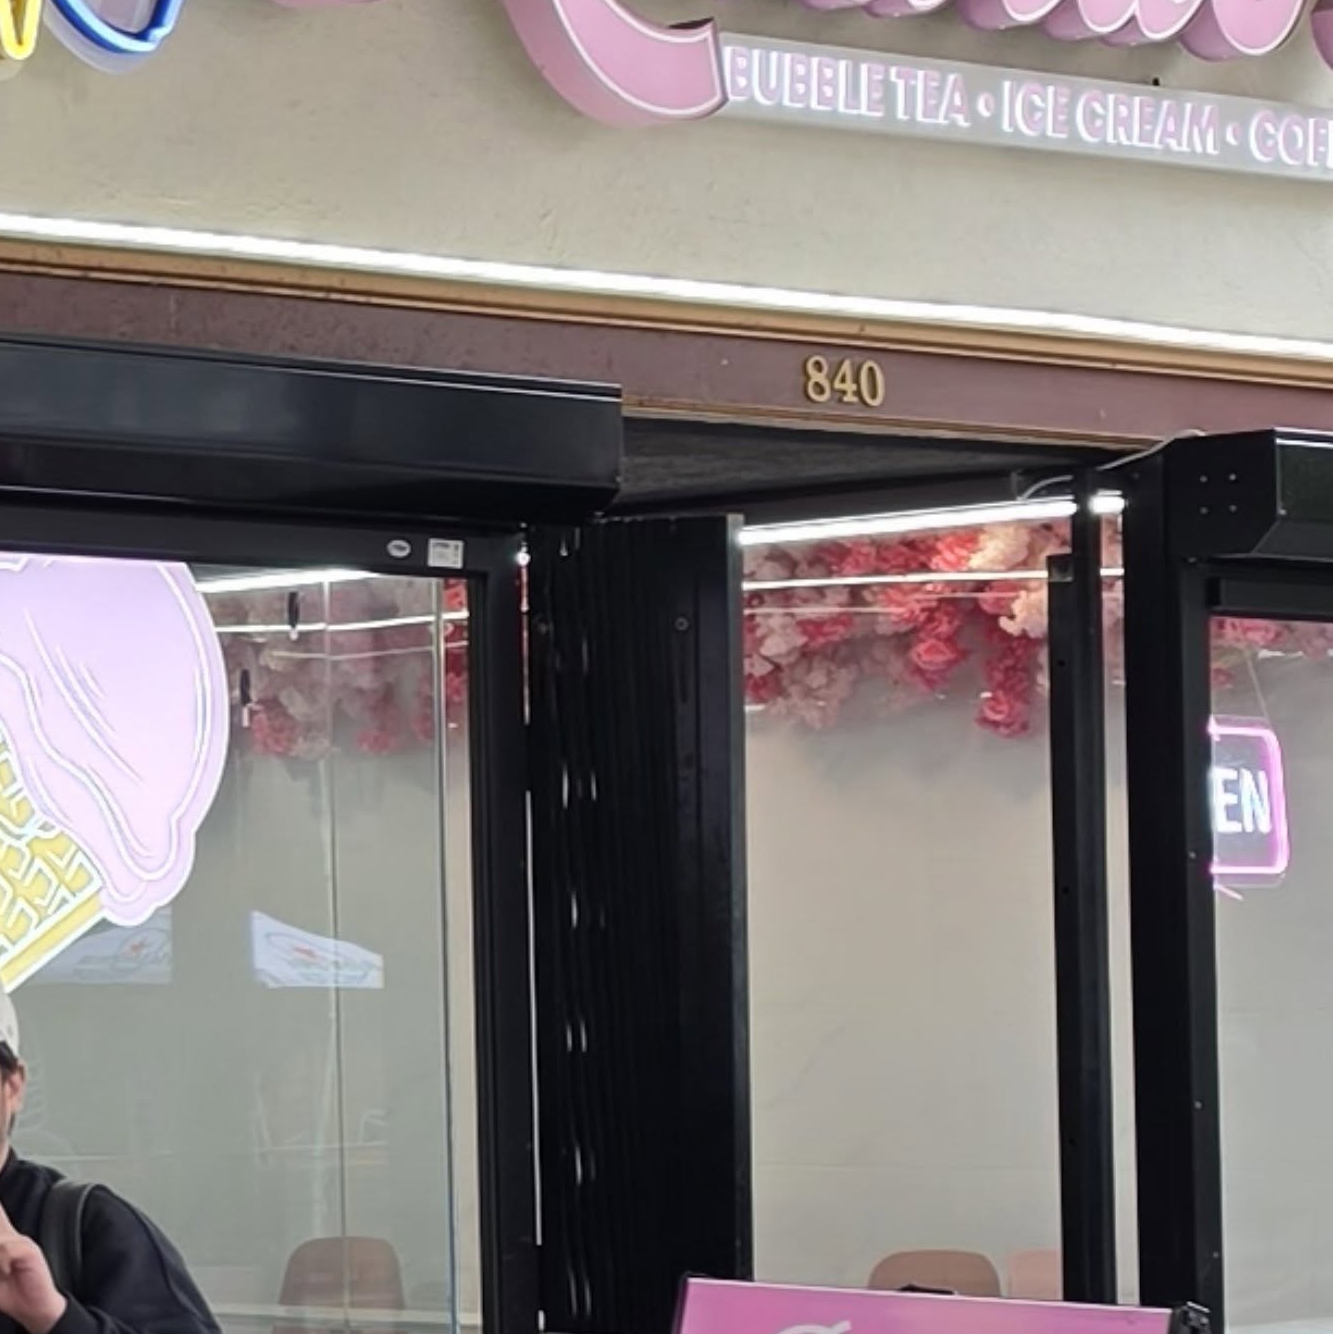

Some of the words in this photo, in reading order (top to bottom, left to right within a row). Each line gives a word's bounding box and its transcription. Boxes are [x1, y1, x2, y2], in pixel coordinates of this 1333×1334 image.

[722, 44, 887, 120] BUBBLE
[888, 67, 971, 127] TEA
[1001, 79, 1070, 140] ICE
[1075, 89, 1221, 155] CREAM
[1249, 109, 1333, 169] COF
[806, 354, 886, 407] 840
